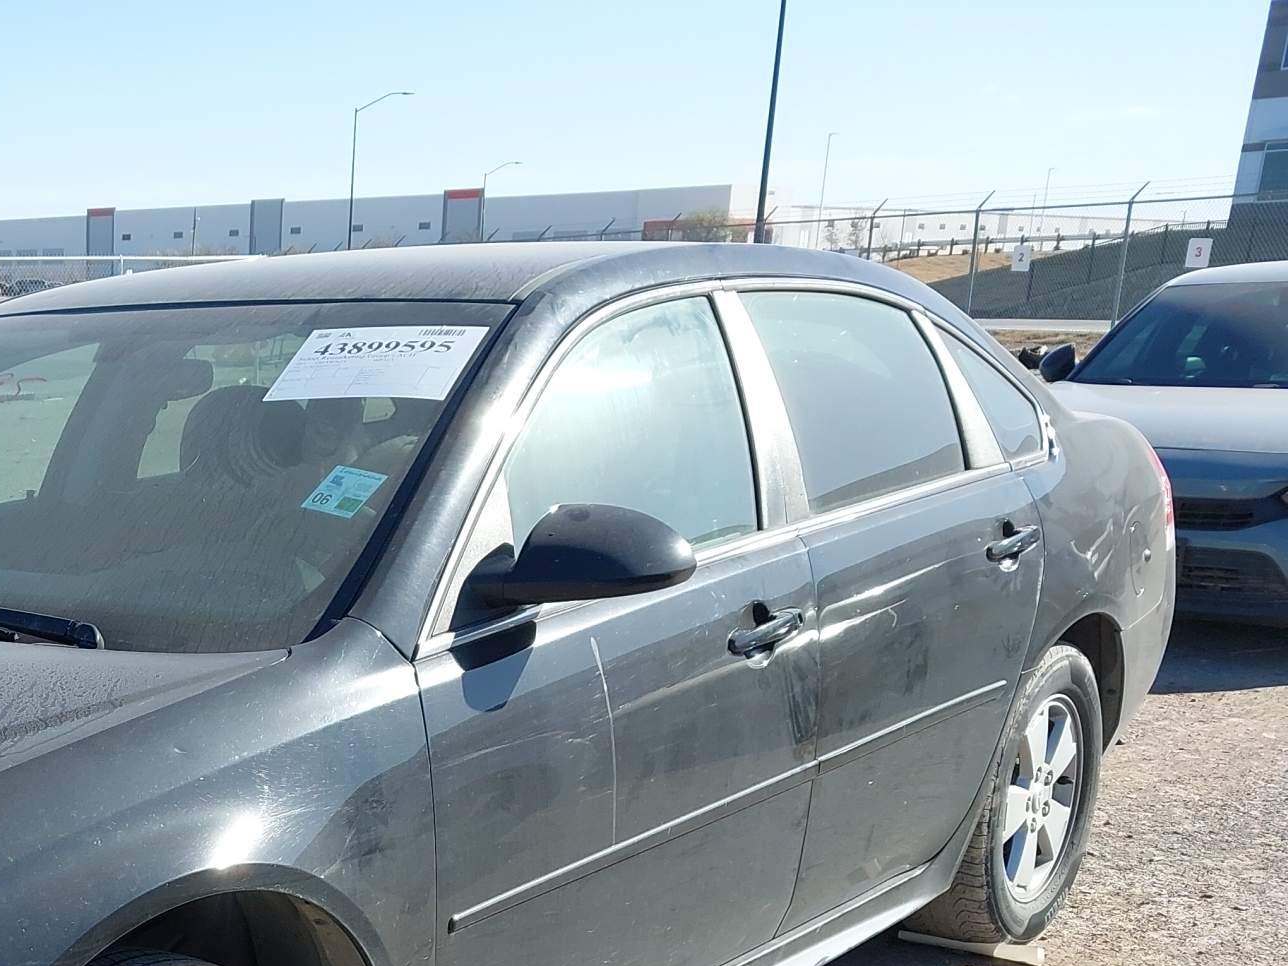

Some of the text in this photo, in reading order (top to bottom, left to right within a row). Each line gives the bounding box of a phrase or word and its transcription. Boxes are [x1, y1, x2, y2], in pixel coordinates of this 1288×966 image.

[1017, 252, 1025, 262] 2
[1194, 246, 1203, 258] 3
[313, 340, 456, 356] 43899595
[312, 492, 332, 505] 06
